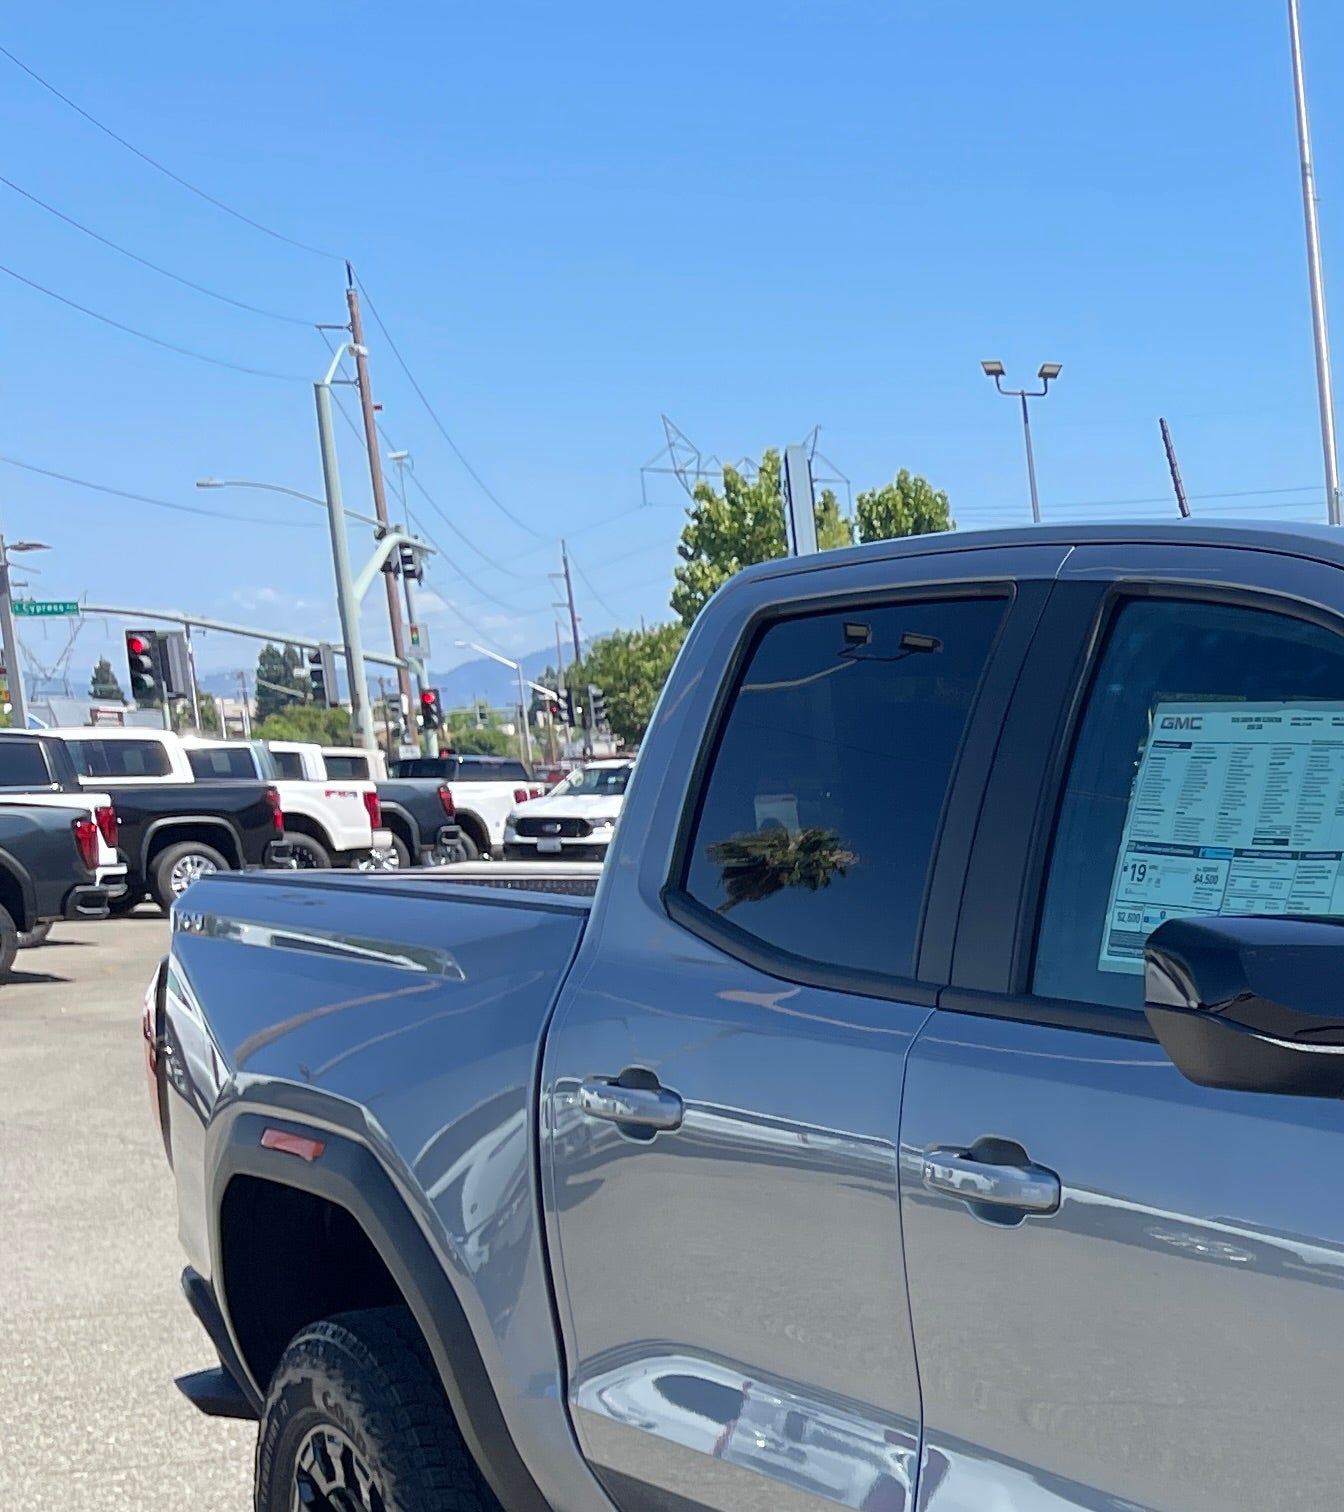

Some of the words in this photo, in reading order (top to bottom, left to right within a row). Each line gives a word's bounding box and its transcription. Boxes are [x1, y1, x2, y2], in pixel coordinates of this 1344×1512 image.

[22, 603, 64, 613] Cypress
[1160, 717, 1203, 730] GMC
[1130, 862, 1148, 883] 19
